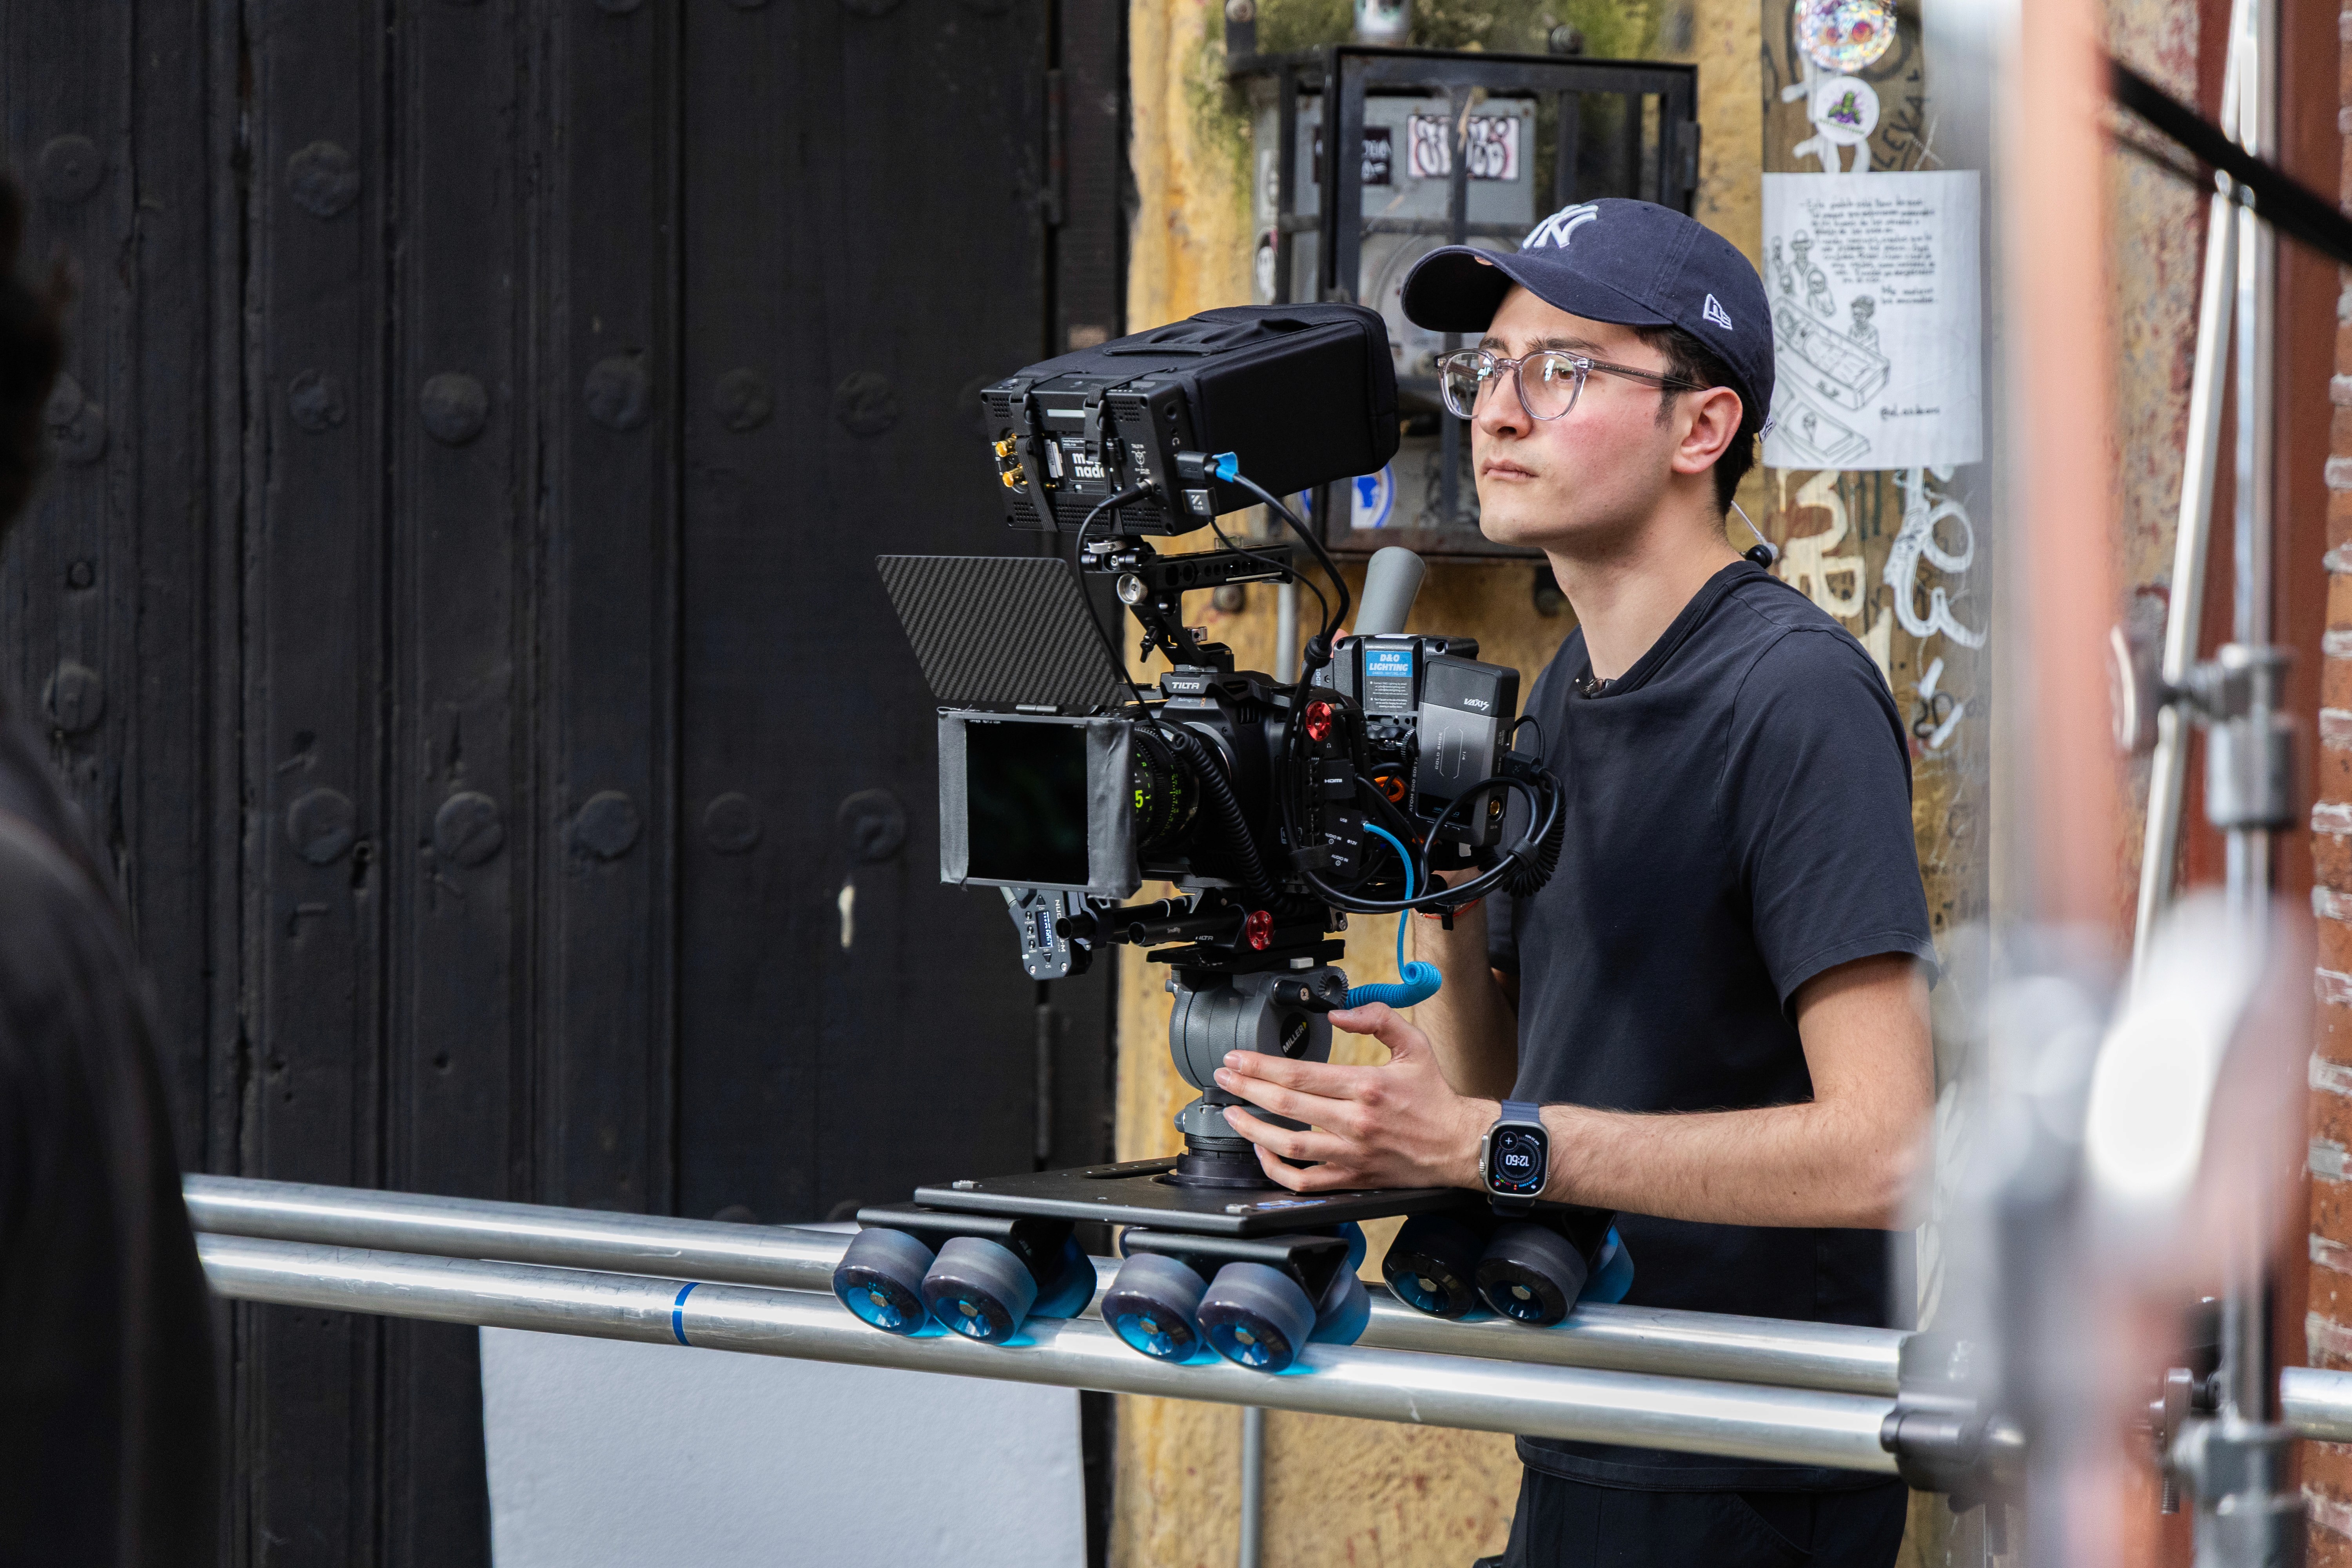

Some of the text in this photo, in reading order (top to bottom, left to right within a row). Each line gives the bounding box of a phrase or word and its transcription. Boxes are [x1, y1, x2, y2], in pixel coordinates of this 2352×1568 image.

[1380, 654, 1400, 662] D&O
[1369, 663, 1408, 671] LIGHTING
[1283, 1024, 1304, 1053] MILLER
[1506, 1154, 1530, 1167] 12:50
